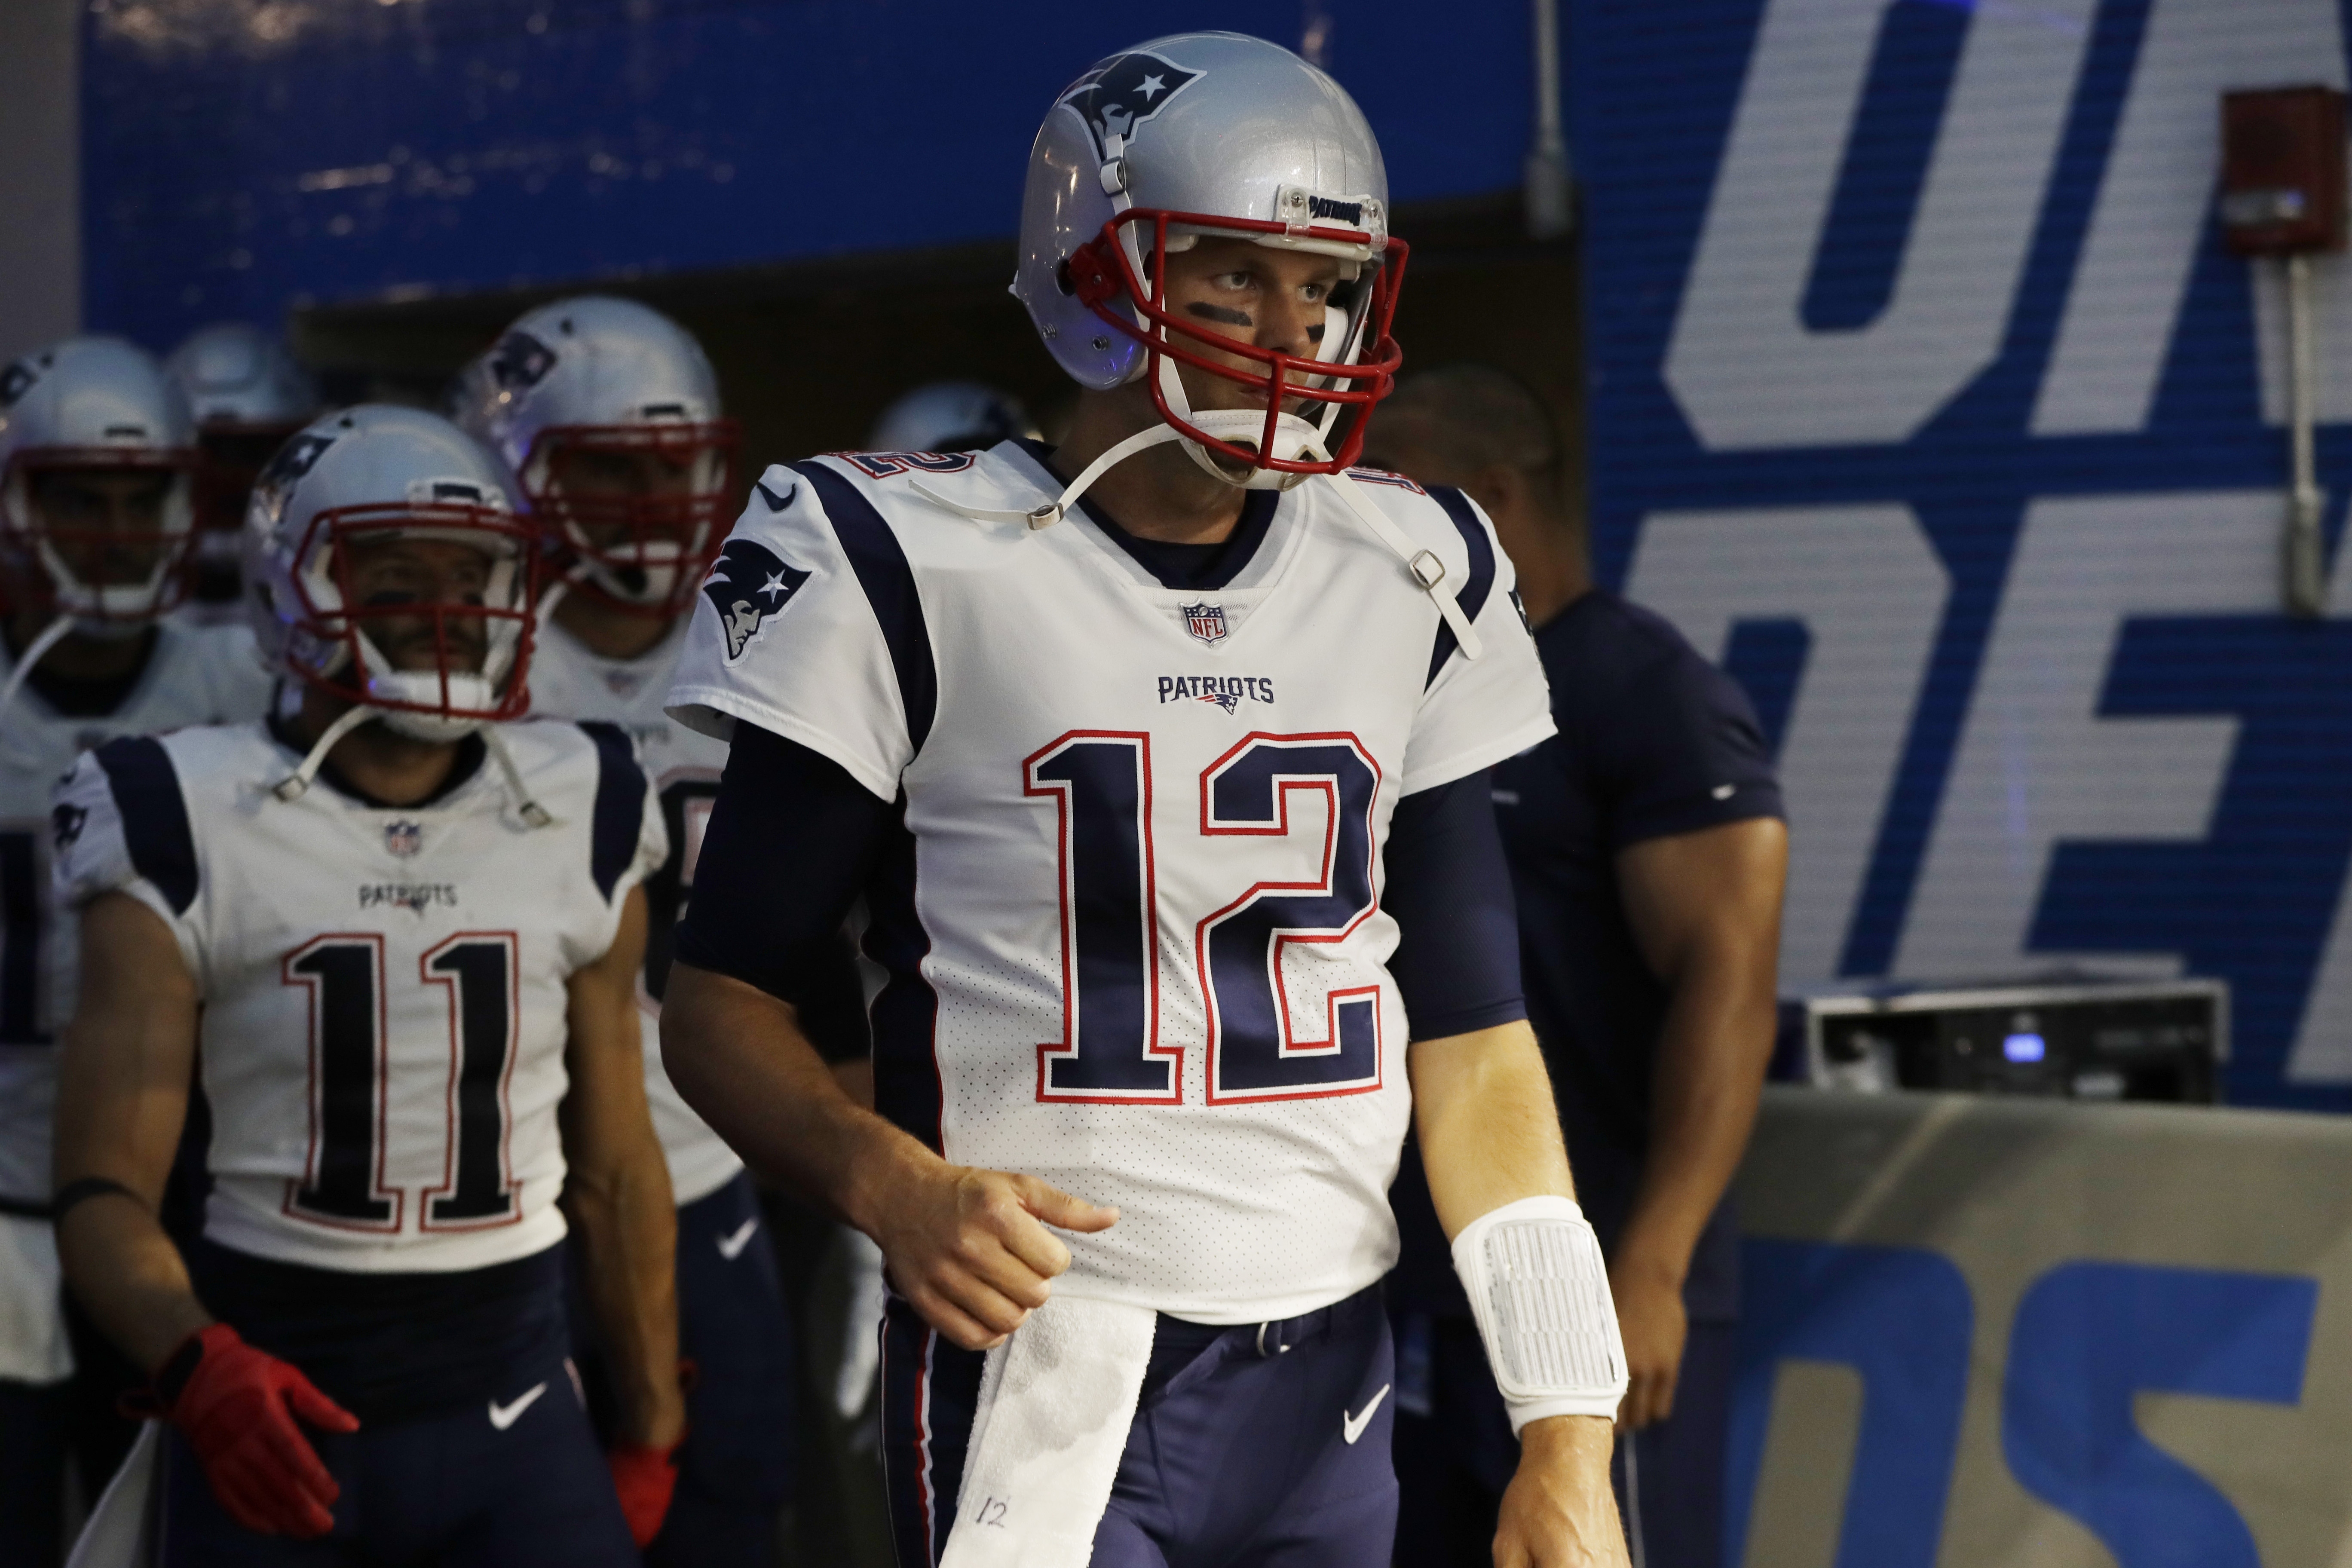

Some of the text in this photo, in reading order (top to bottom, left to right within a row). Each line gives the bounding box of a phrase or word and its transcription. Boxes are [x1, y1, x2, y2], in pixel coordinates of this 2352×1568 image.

[1190, 618, 1223, 637] NFL
[1158, 676, 1274, 704] PATRIOTS
[358, 884, 457, 910] PATRIOTS
[1023, 729, 1382, 1107] 12
[281, 929, 522, 1234] 11
[975, 1495, 1008, 1529] 12
